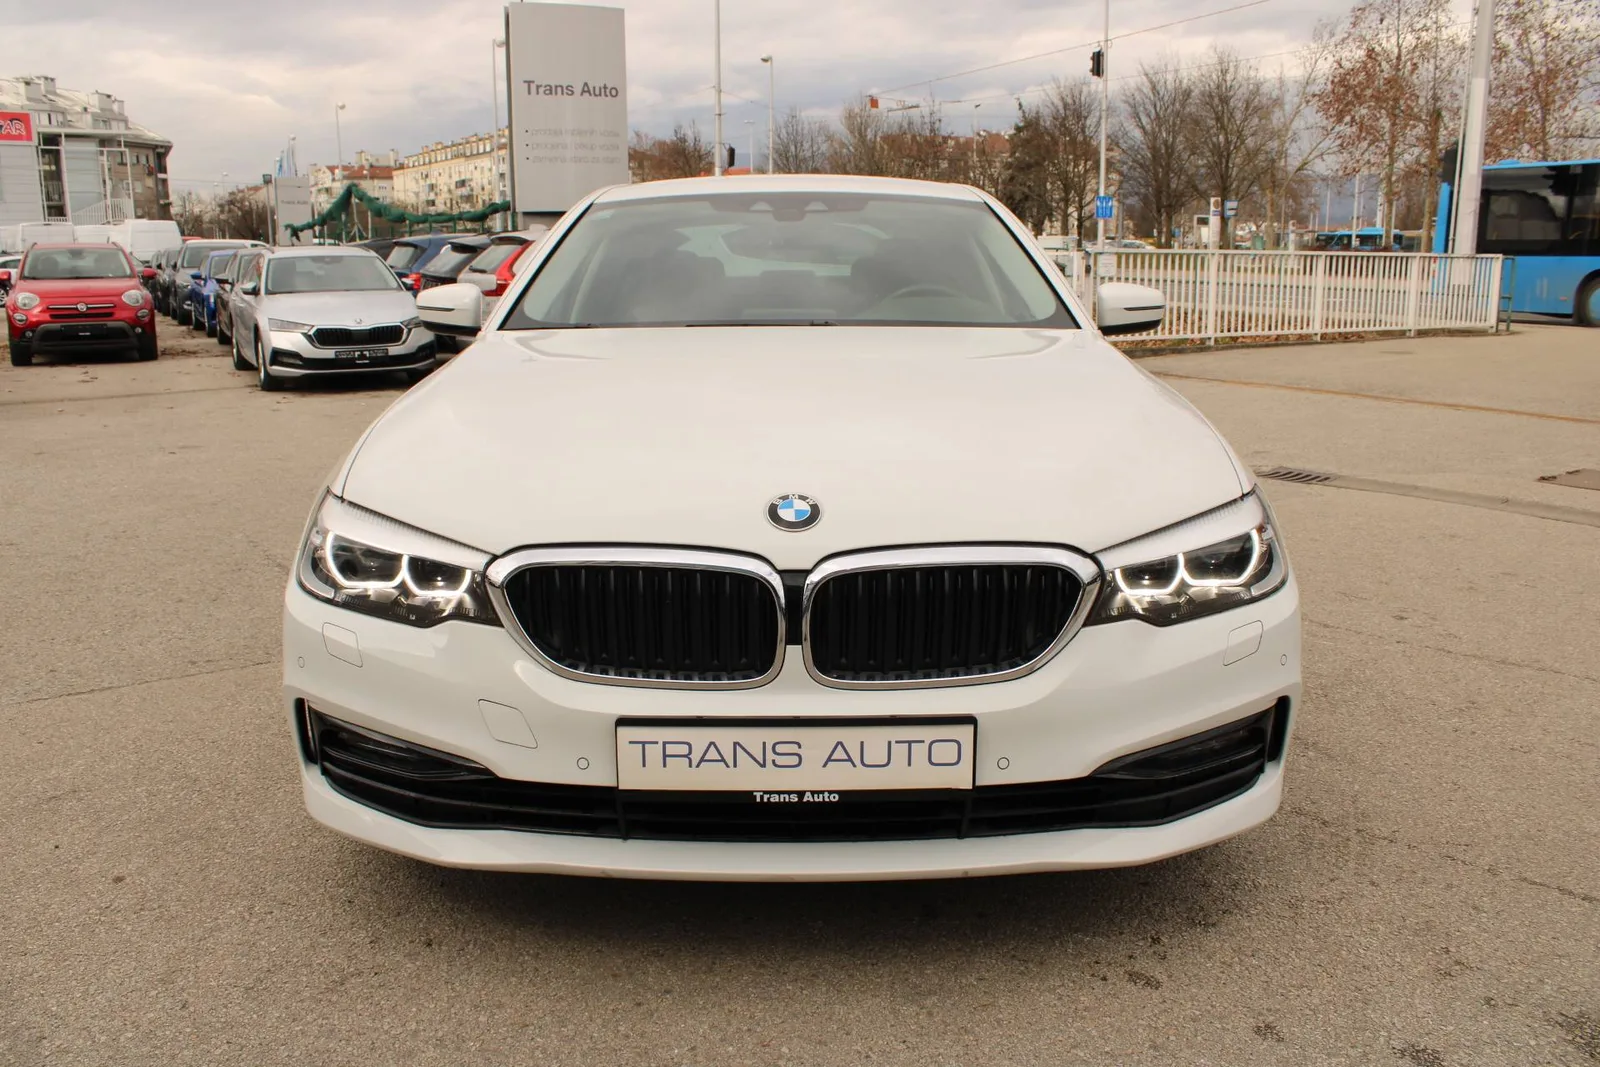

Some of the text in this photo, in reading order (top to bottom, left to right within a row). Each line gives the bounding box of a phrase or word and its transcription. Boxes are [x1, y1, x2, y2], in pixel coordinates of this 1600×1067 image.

[523, 80, 619, 98] Trans Auto
[771, 493, 817, 505] BMW
[628, 739, 962, 768] TRANS AUTO
[753, 791, 839, 802] Trans Auto
